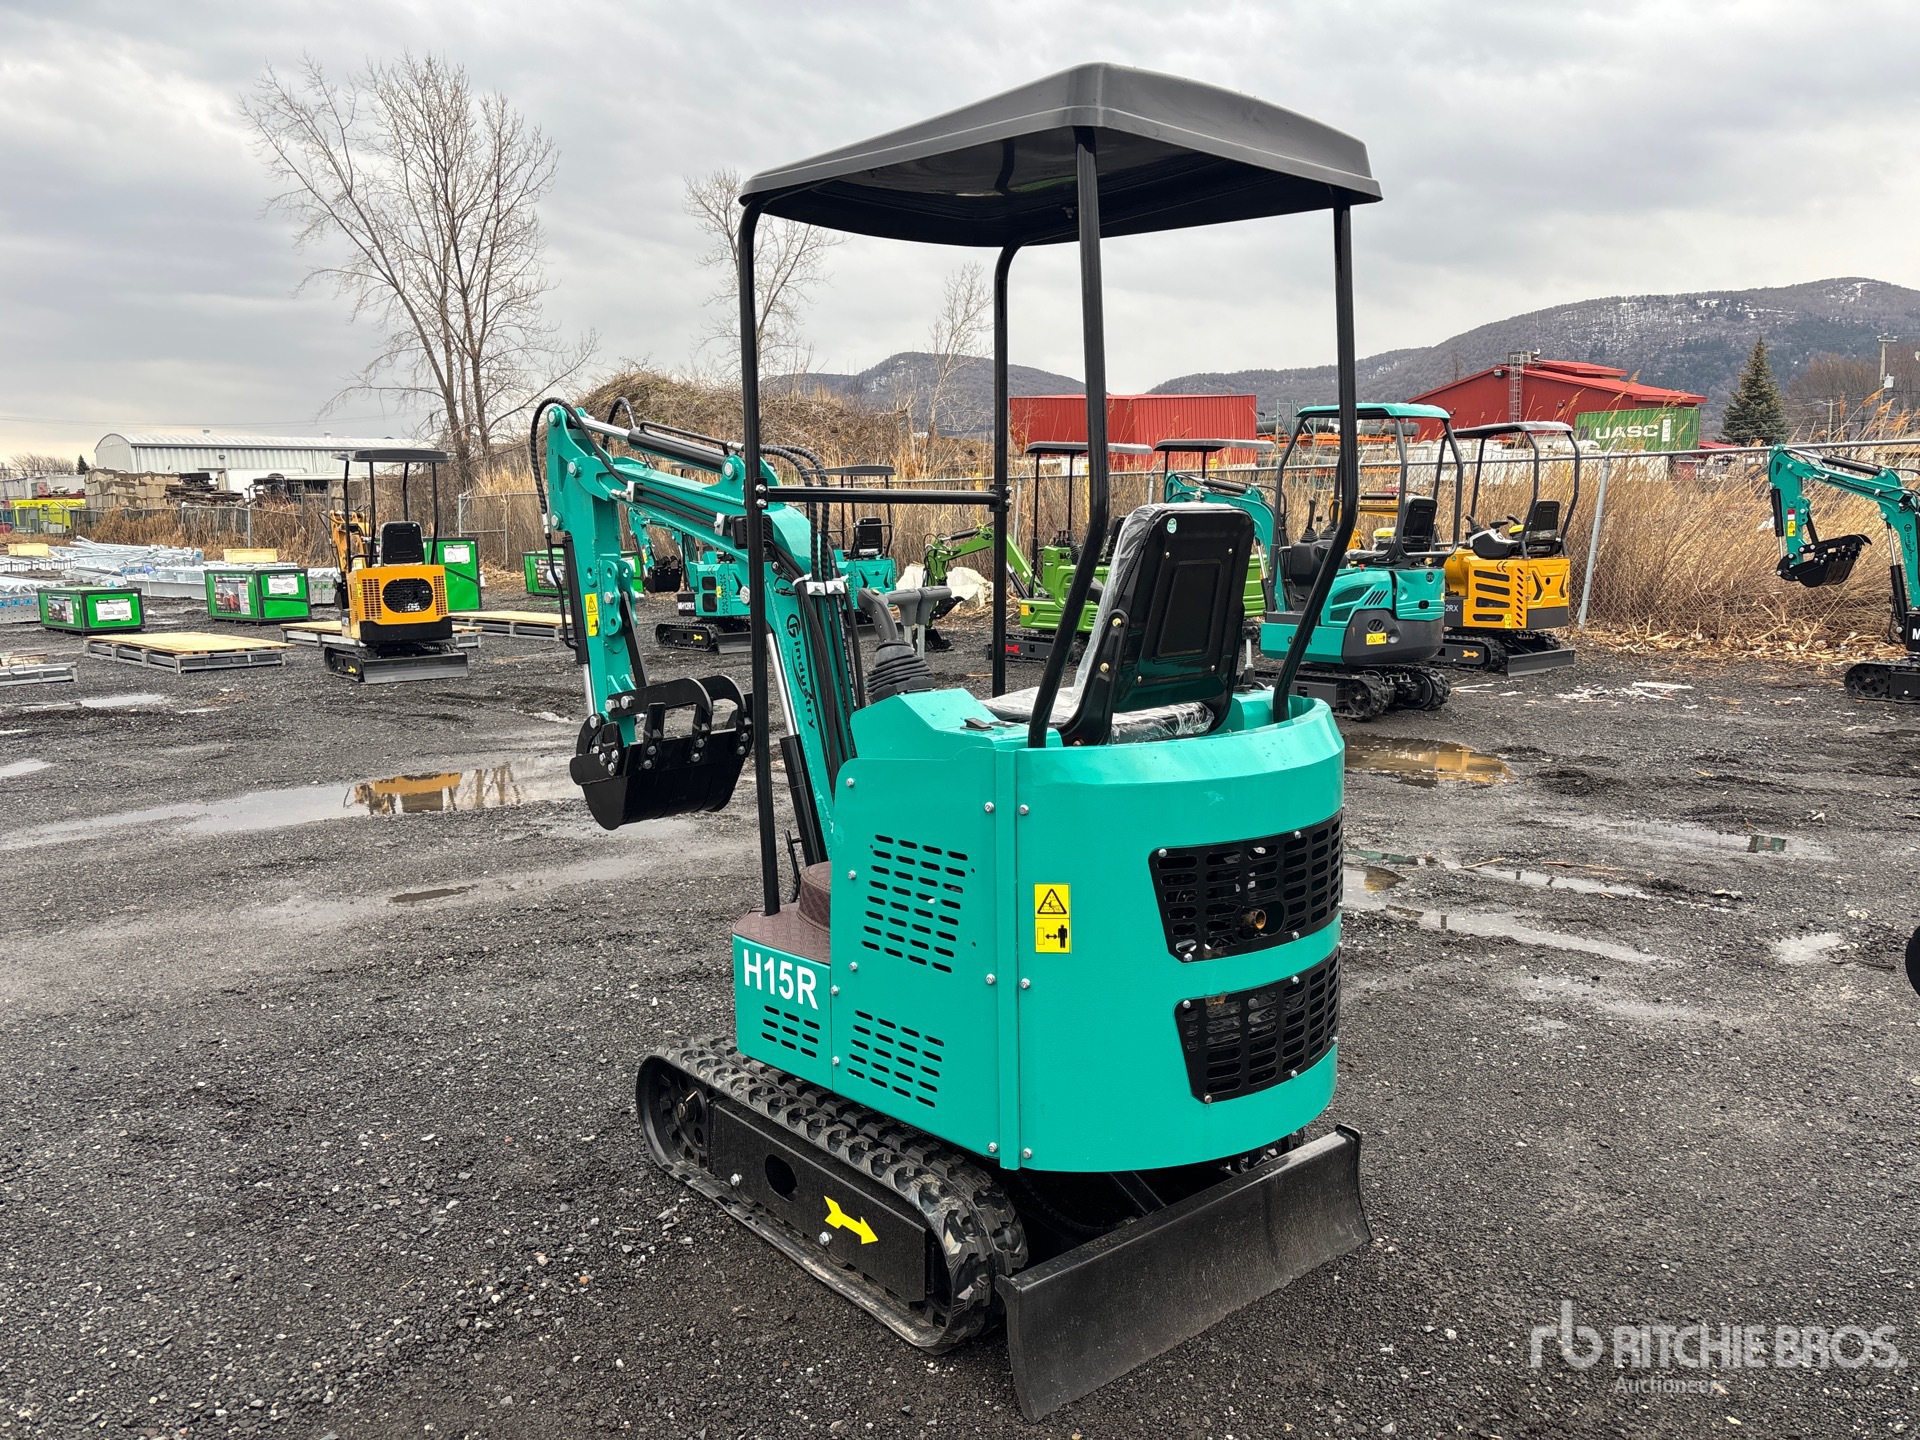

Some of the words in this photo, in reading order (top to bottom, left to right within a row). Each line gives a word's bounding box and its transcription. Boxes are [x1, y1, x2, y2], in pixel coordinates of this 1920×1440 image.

[1595, 424, 1659, 440] UASC
[1445, 604, 1459, 613] 2RX
[793, 640, 815, 729] industry
[743, 948, 819, 1011] H15R
